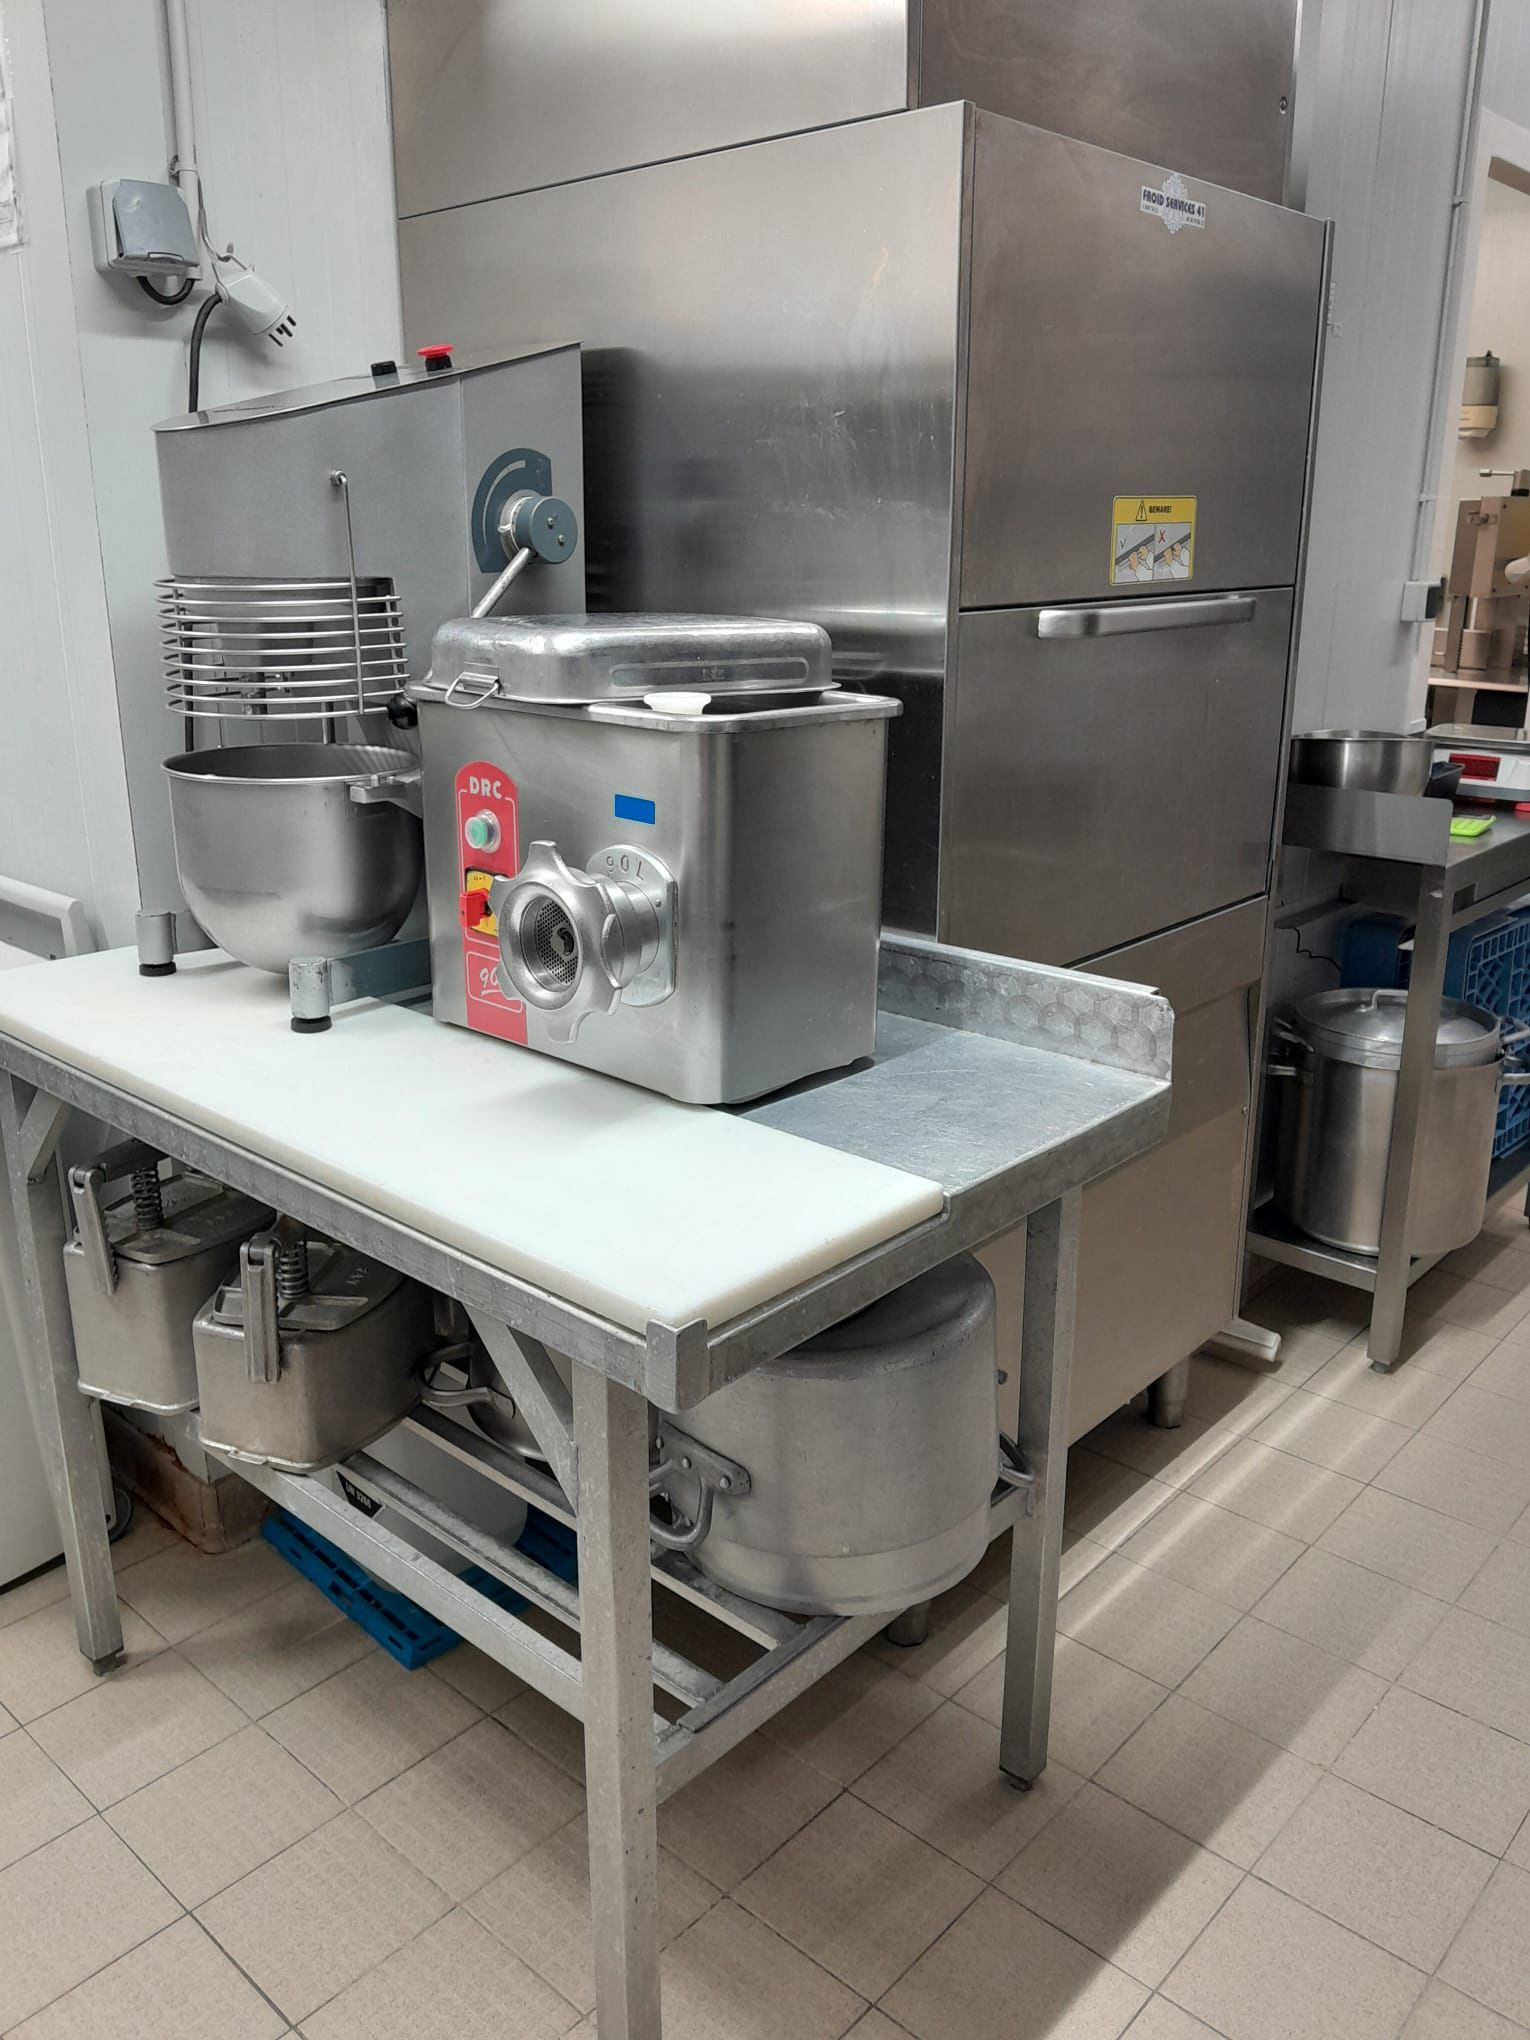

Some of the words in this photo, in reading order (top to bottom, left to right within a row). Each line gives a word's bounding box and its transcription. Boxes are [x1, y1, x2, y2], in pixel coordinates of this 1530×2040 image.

[1143, 190, 1164, 205] FROID
[1166, 196, 1195, 215] SERVICES
[1197, 205, 1204, 217] 41
[1149, 505, 1172, 513] BEWARE!
[469, 775, 503, 800] DRC
